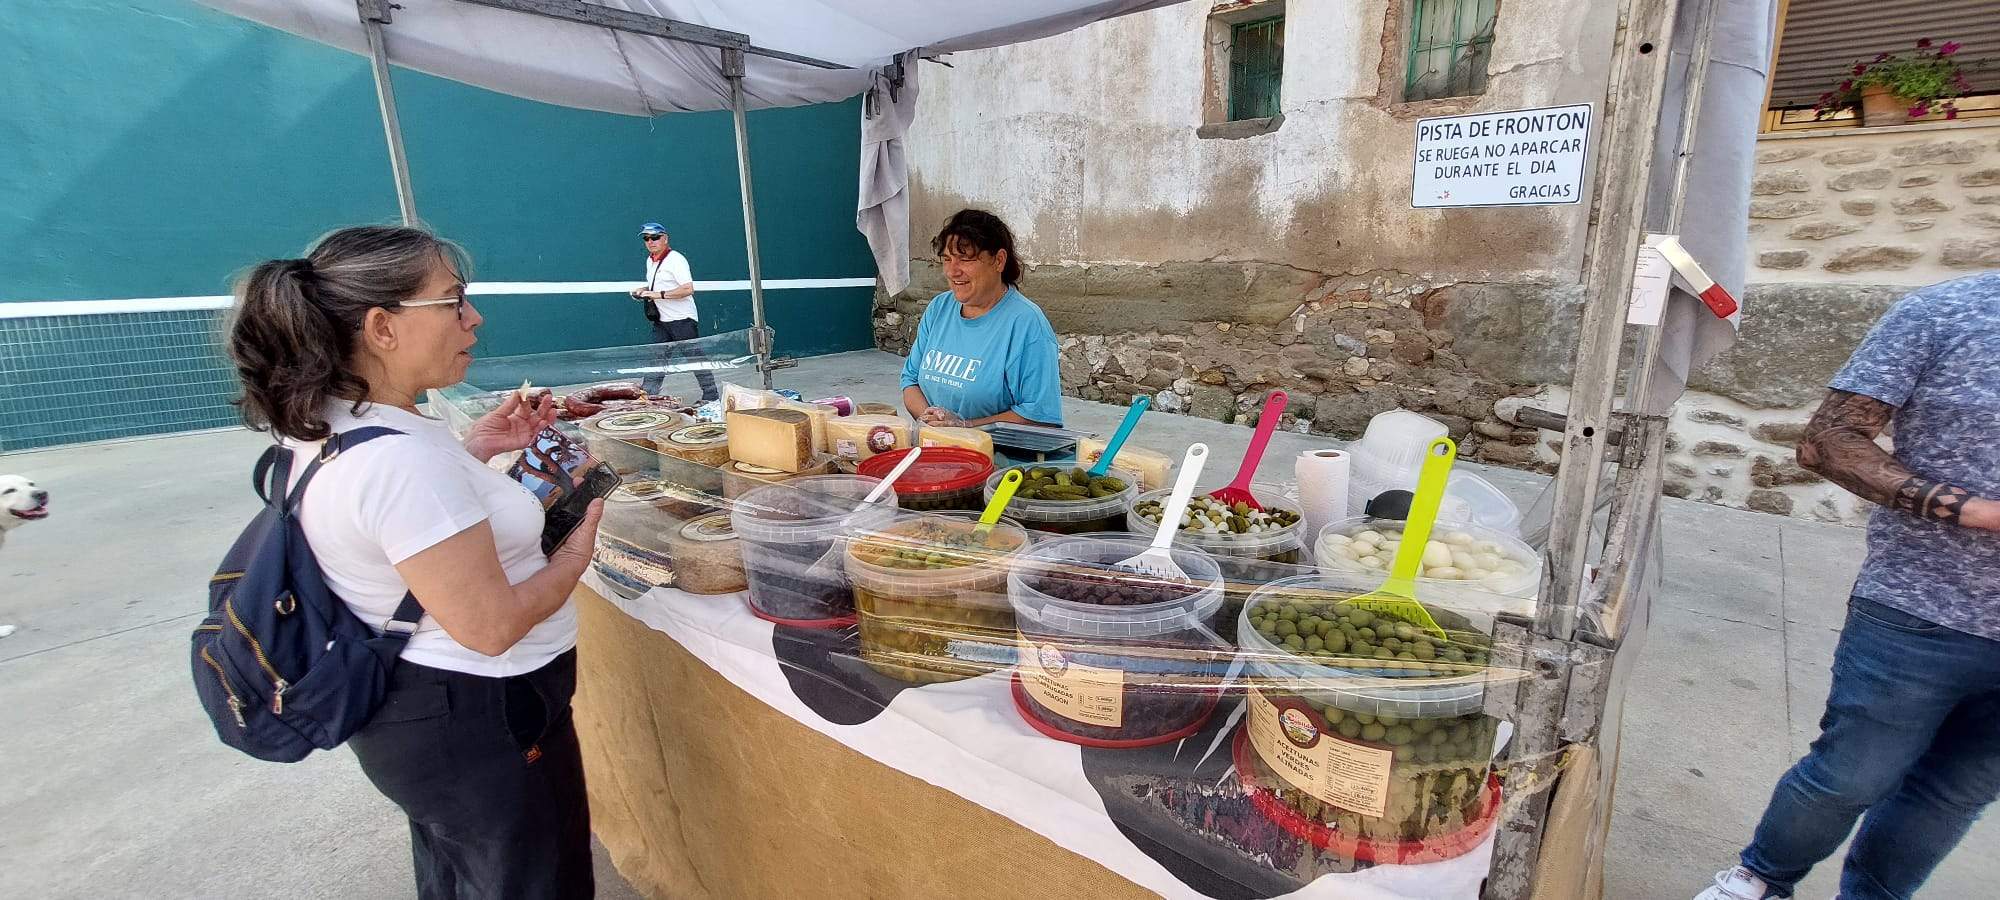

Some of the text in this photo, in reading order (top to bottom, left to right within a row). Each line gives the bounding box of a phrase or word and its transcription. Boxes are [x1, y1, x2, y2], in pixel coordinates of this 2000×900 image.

[1420, 112, 1586, 141] PISTA DE FRONTON
[1419, 139, 1581, 162] SE RUEGA NO APARCAR
[1434, 160, 1556, 179] DURANTE EL DIA
[1509, 184, 1571, 199] GRACIAS
[922, 350, 982, 381] SMILE
[1038, 674, 1069, 691] ACEITUNAS
[1276, 740, 1320, 767] ACEITUNAS
[1281, 749, 1310, 771] VERDES
